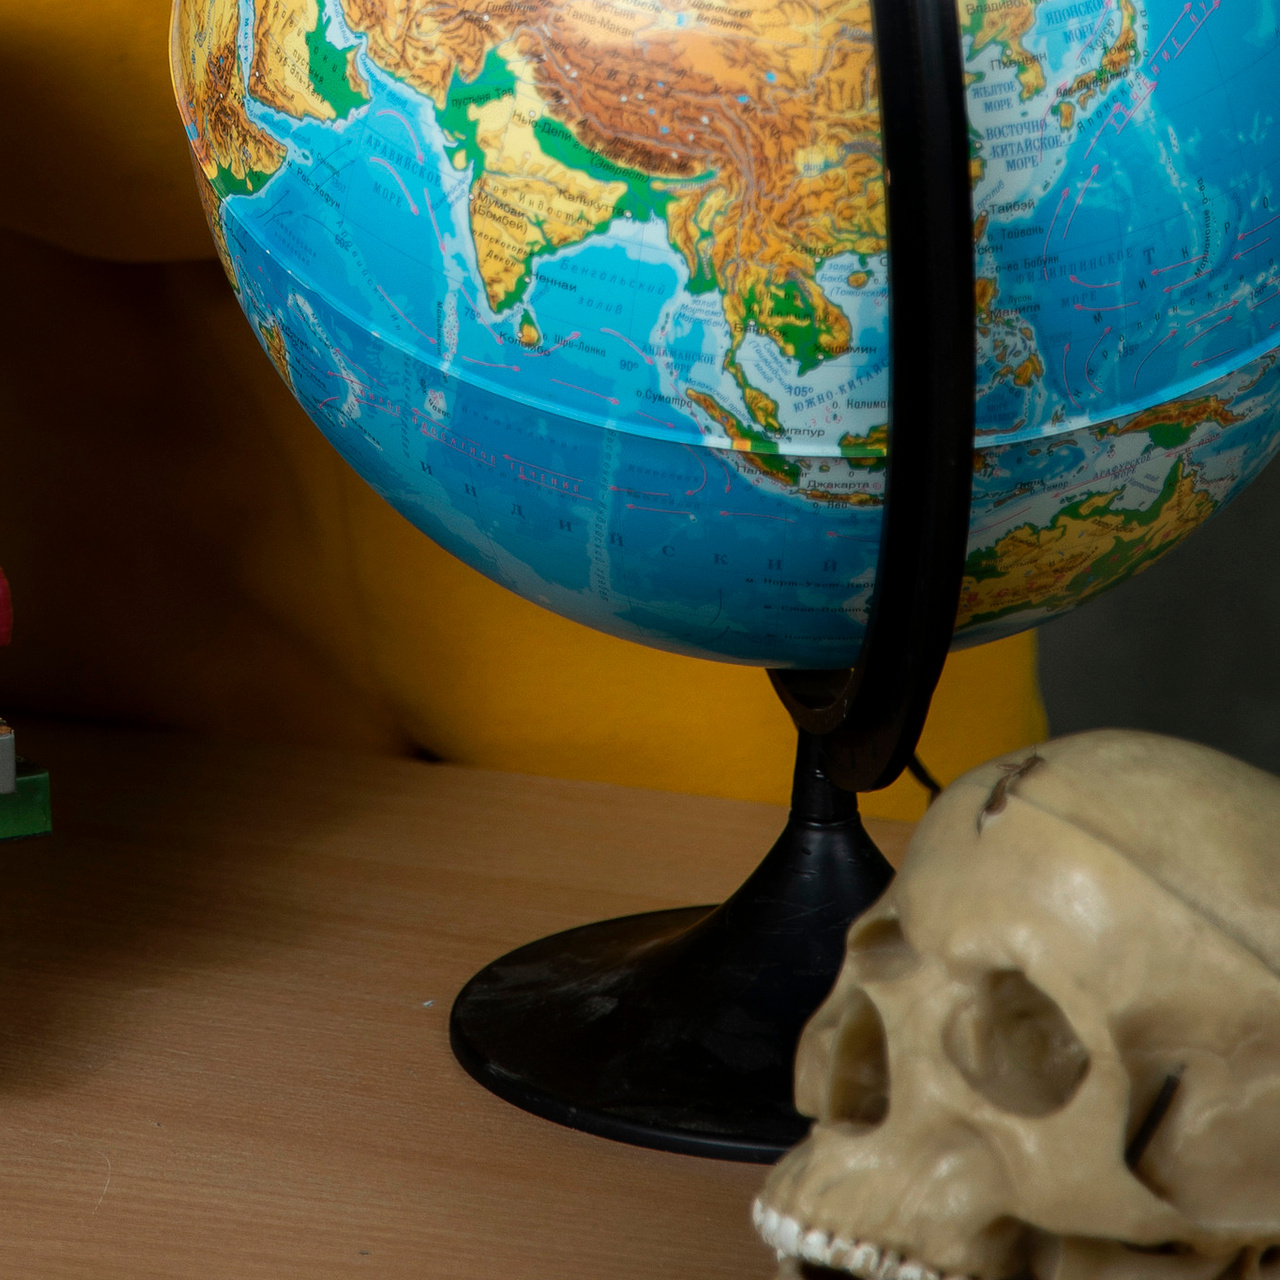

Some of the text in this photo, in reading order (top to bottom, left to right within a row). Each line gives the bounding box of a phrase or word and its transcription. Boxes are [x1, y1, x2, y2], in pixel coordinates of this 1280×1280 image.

[1062, 23, 1096, 44] МОРЕ
[990, 51, 1048, 72] Пхеньян
[452, 92, 491, 108] пустыня
[972, 81, 1017, 113] ЖЕЛТОЕ МОРЕ
[512, 110, 573, 142] Нью-Дели
[986, 119, 1065, 173] ВОСТОЧНО- -КИТАЙСКОЕ МОРЕ
[296, 166, 341, 210] Рас-Хафун
[373, 181, 405, 209] МОРЕ
[558, 187, 625, 218] Калькутта
[989, 199, 1036, 216] Тайбэй
[473, 191, 529, 236] Мумбаи (Бомбей)
[1002, 226, 1044, 241] Тайвань
[789, 244, 835, 257] Ханой
[559, 258, 667, 297] Бенгальский
[578, 295, 623, 316] залив
[990, 302, 1041, 318] Манила
[806, 480, 870, 491] Джакарта
